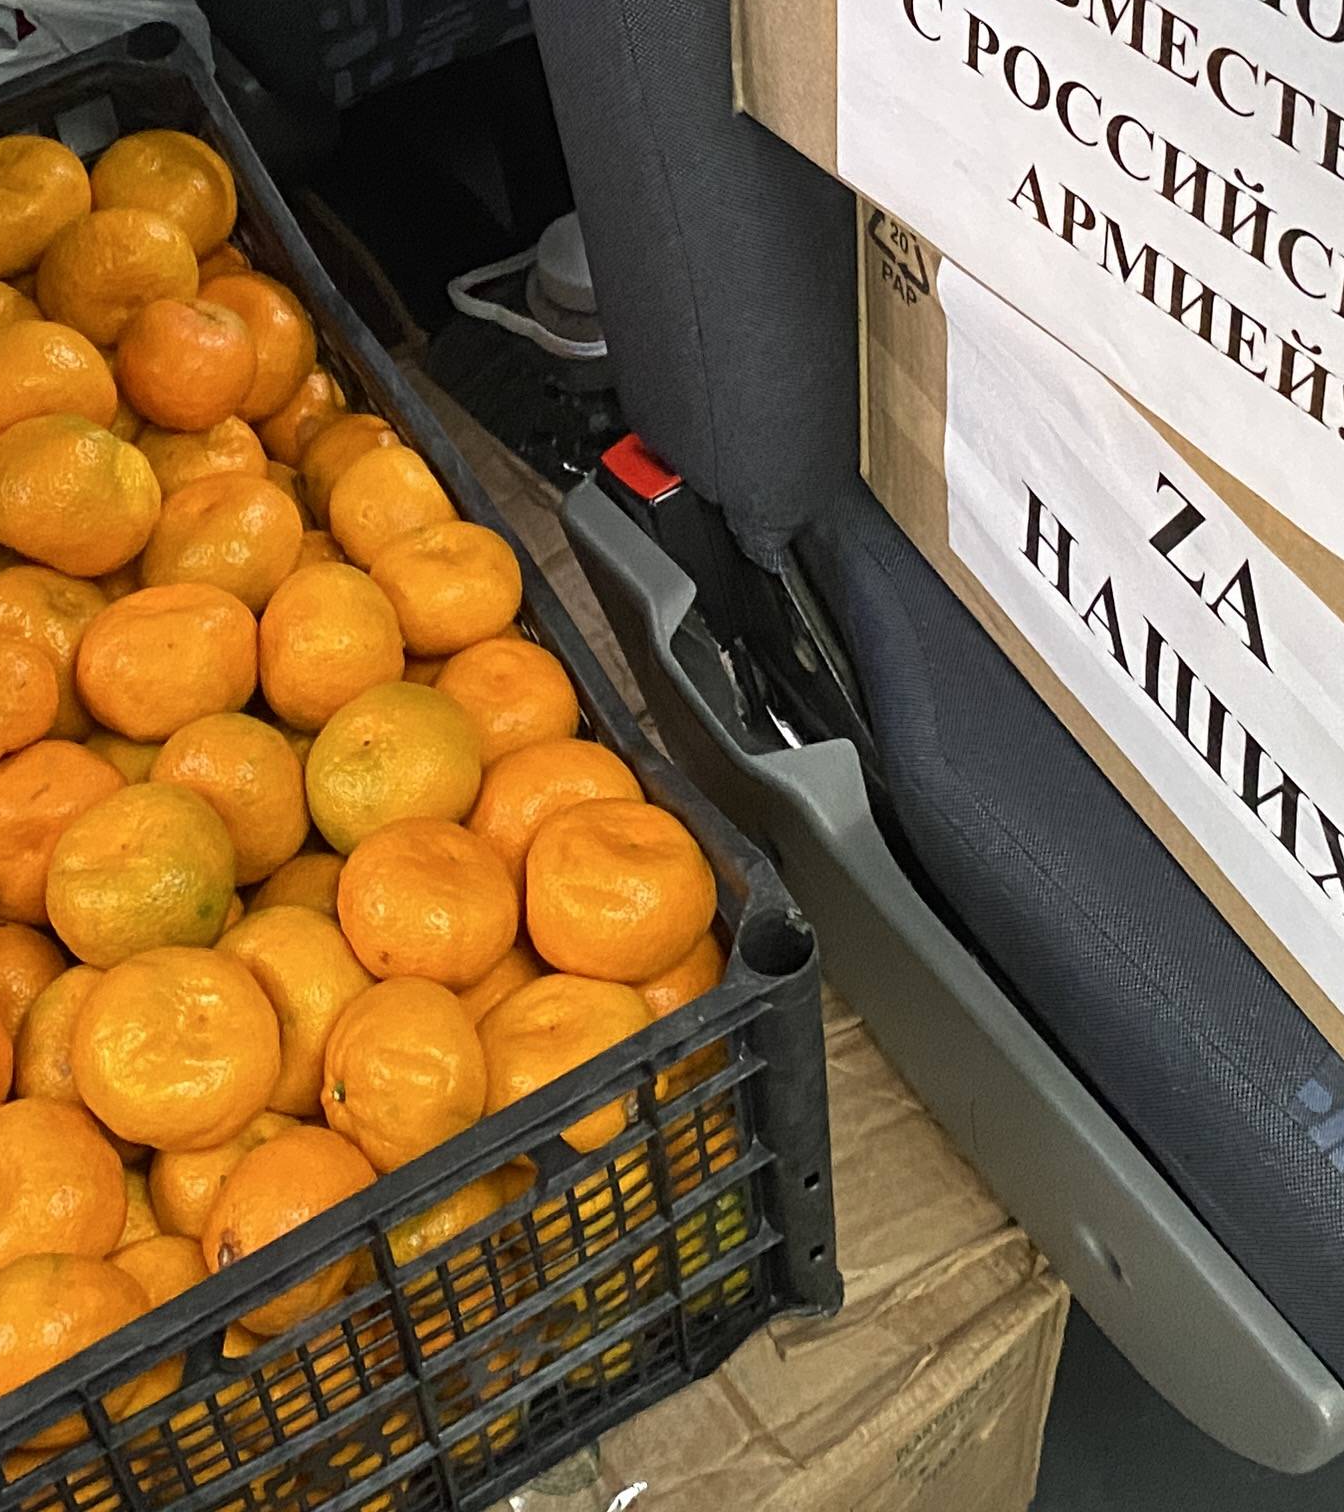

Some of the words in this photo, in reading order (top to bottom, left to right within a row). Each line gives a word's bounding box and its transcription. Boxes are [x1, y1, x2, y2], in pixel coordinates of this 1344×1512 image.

[890, 218, 908, 254] 20
[881, 259, 918, 308] PAP
[1148, 471, 1273, 673] ZA
